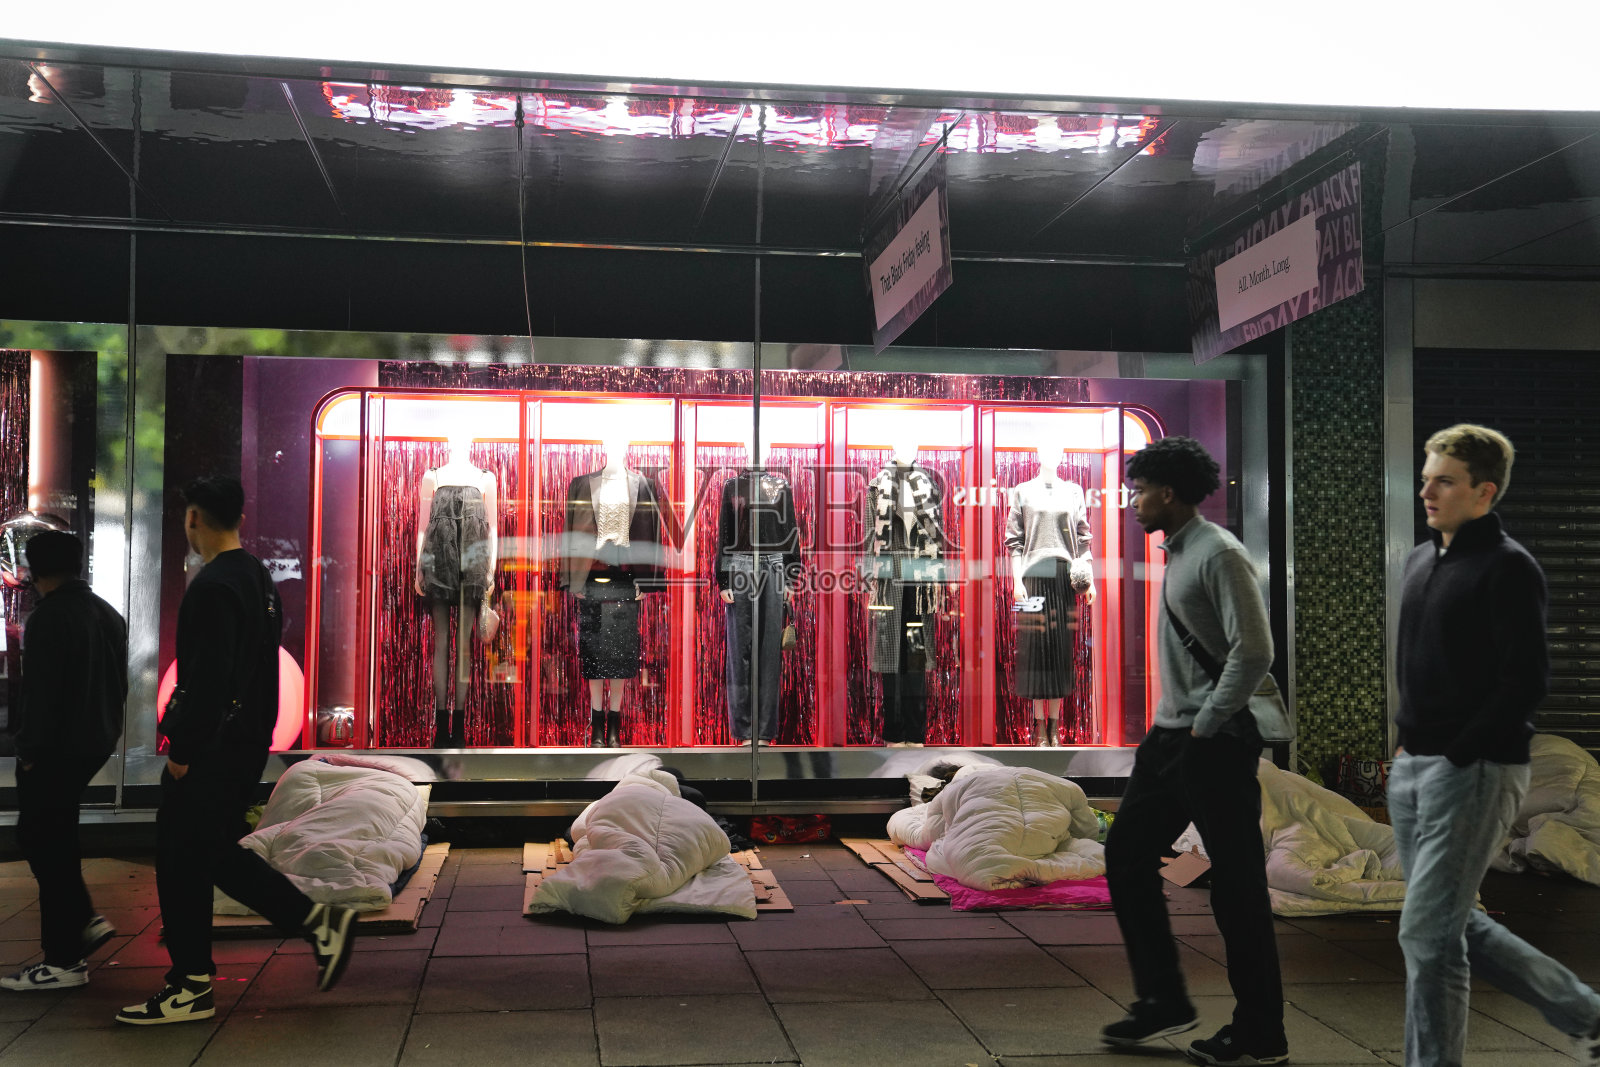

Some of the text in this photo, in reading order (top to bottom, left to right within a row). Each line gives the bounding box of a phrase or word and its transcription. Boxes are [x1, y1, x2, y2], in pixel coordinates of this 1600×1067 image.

[1300, 168, 1352, 219] BLACK
[880, 273, 892, 295] That
[890, 258, 904, 286] Black
[902, 247, 916, 273] Friday
[915, 230, 931, 260] feeling
[1238, 276, 1249, 293] All.
[1249, 265, 1272, 288] Month.
